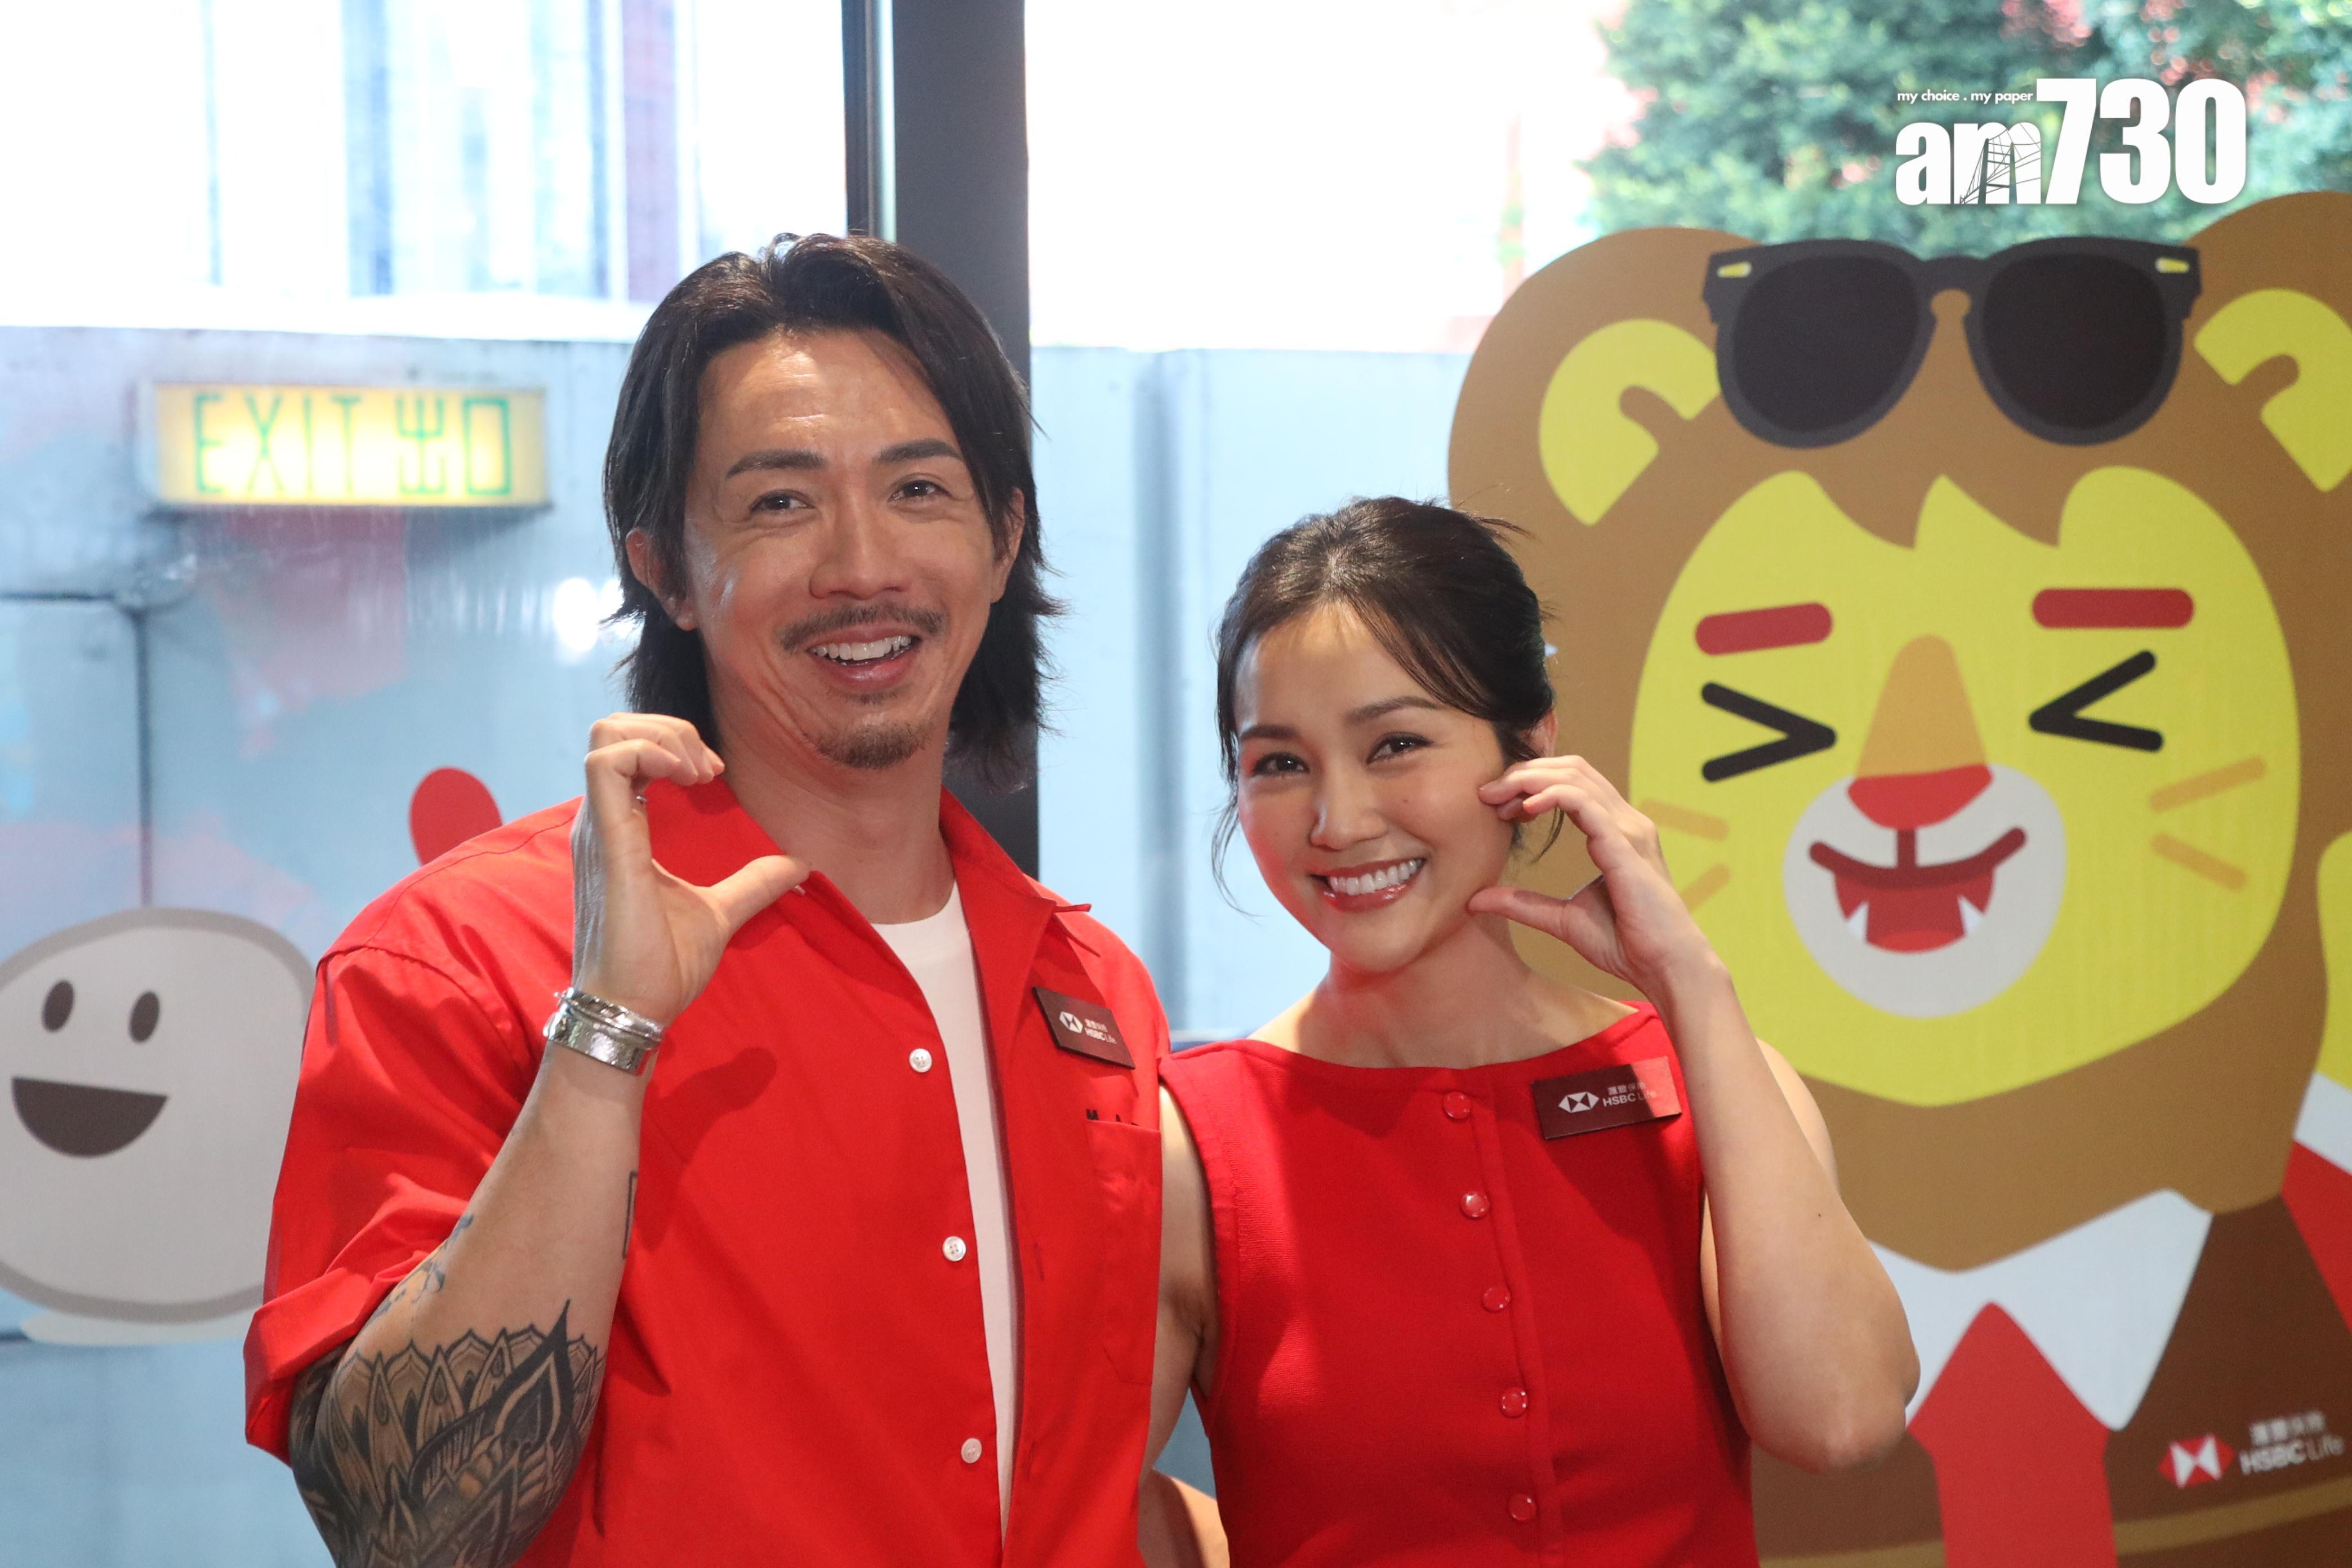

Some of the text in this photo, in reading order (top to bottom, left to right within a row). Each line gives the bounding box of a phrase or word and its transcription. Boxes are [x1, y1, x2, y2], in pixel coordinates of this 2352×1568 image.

[193, 393, 363, 495] EXIT
[395, 394, 511, 496] 出口
[1084, 1027, 1106, 1041] HSBC
[1602, 1093, 1636, 1107] HSBC
[2240, 1440, 2308, 1476] HSBC
